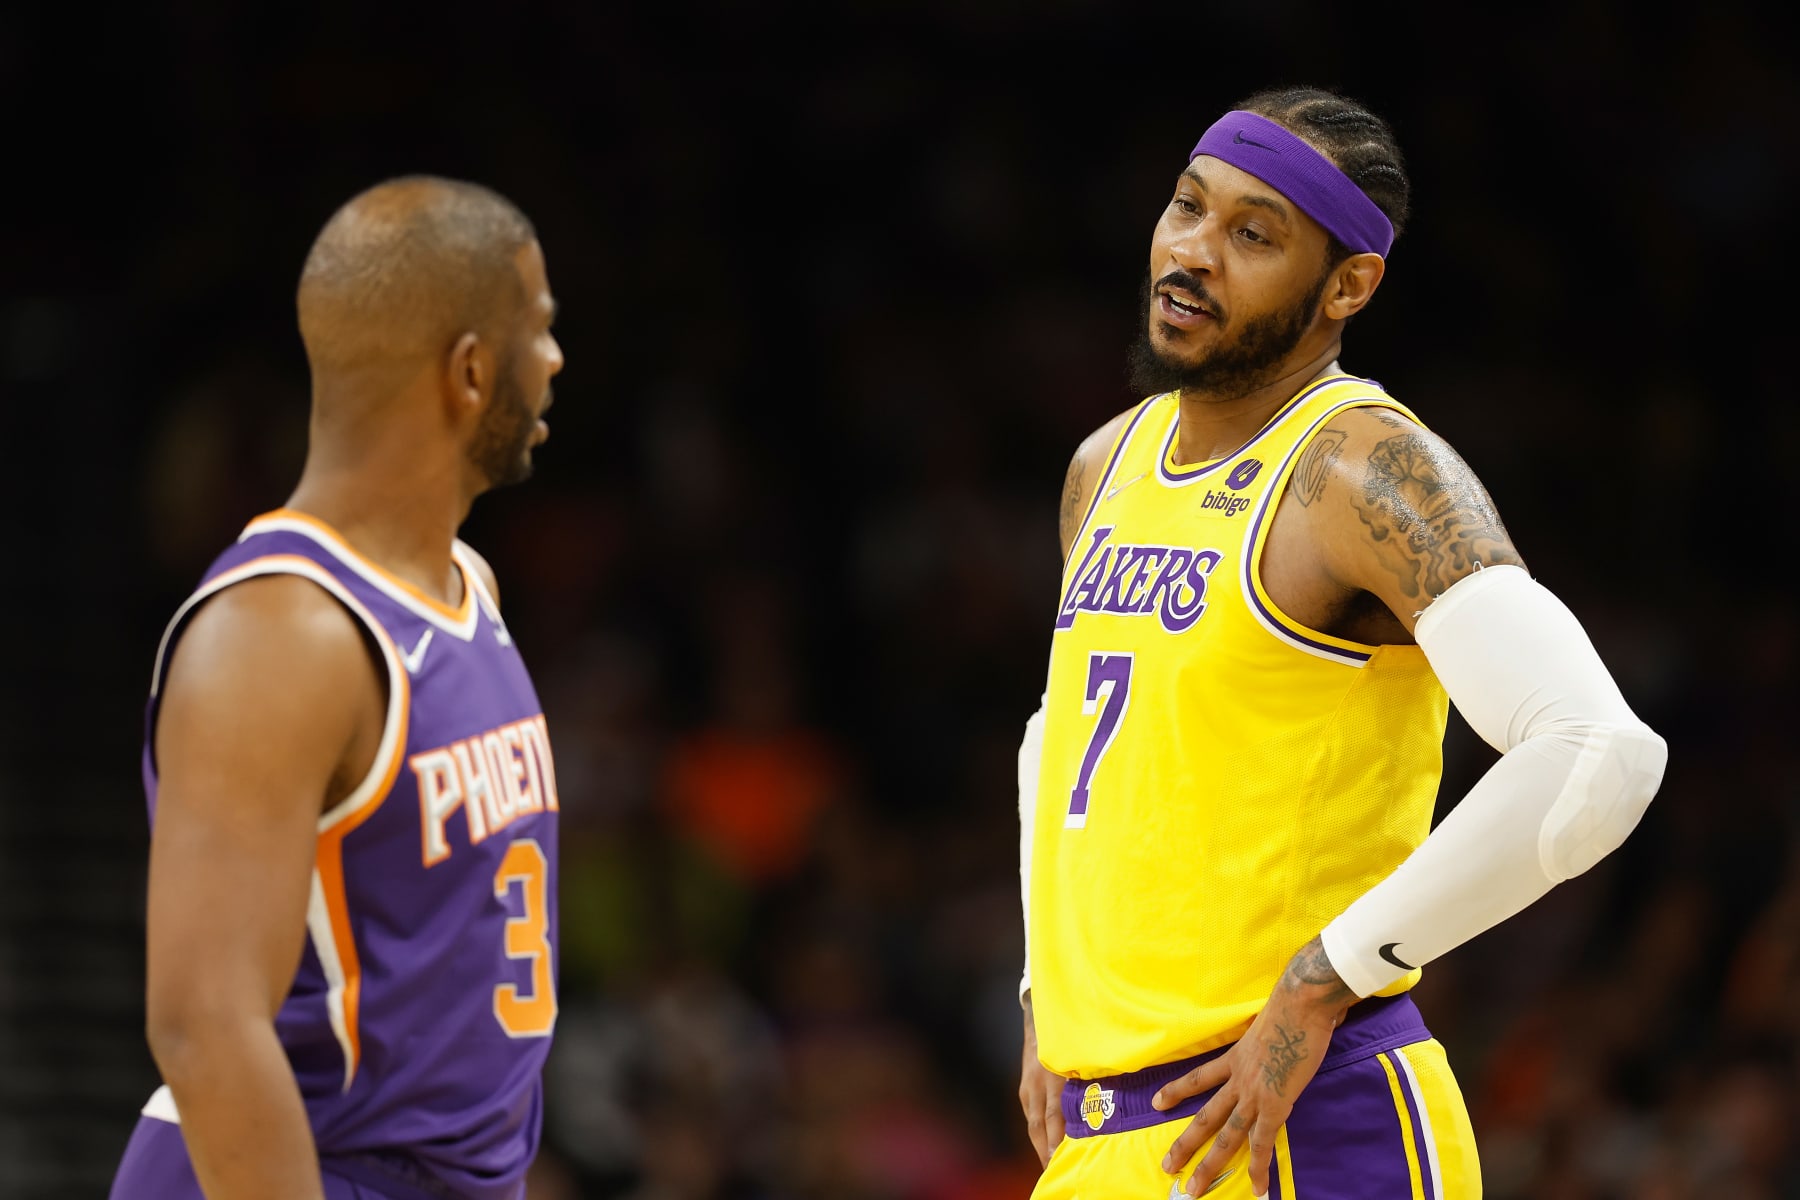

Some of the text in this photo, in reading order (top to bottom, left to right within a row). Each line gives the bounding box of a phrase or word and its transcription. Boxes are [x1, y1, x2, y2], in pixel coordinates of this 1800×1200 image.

[1201, 490, 1250, 517] bibigo
[1055, 525, 1224, 634] LAKERS
[1064, 650, 1135, 829] 7
[494, 839, 559, 1038] 3
